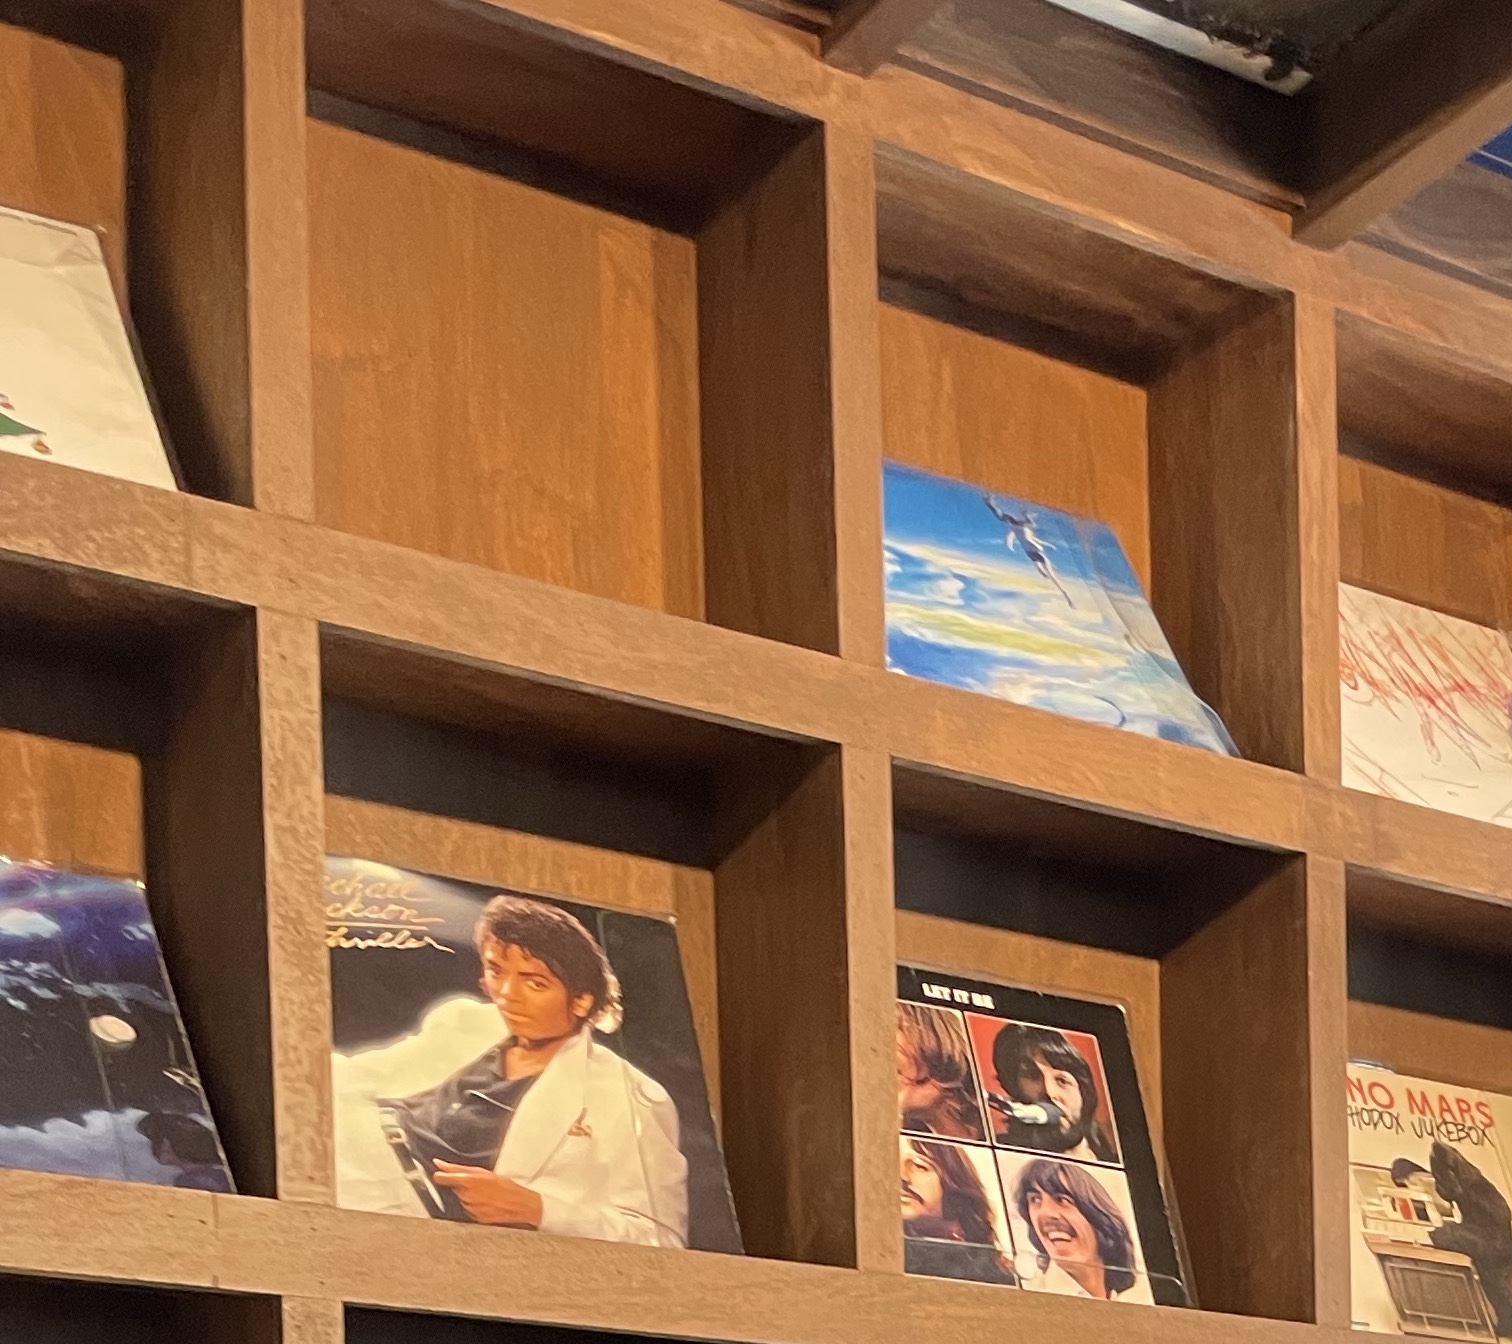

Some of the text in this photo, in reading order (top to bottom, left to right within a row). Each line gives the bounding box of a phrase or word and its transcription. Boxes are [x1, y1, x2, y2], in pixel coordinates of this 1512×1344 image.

[325, 892, 447, 926] ckson
[921, 982, 995, 1010] LET IT BE
[1406, 1088, 1496, 1128] MARS
[1347, 1105, 1499, 1150] HODOX JUKEBOX
